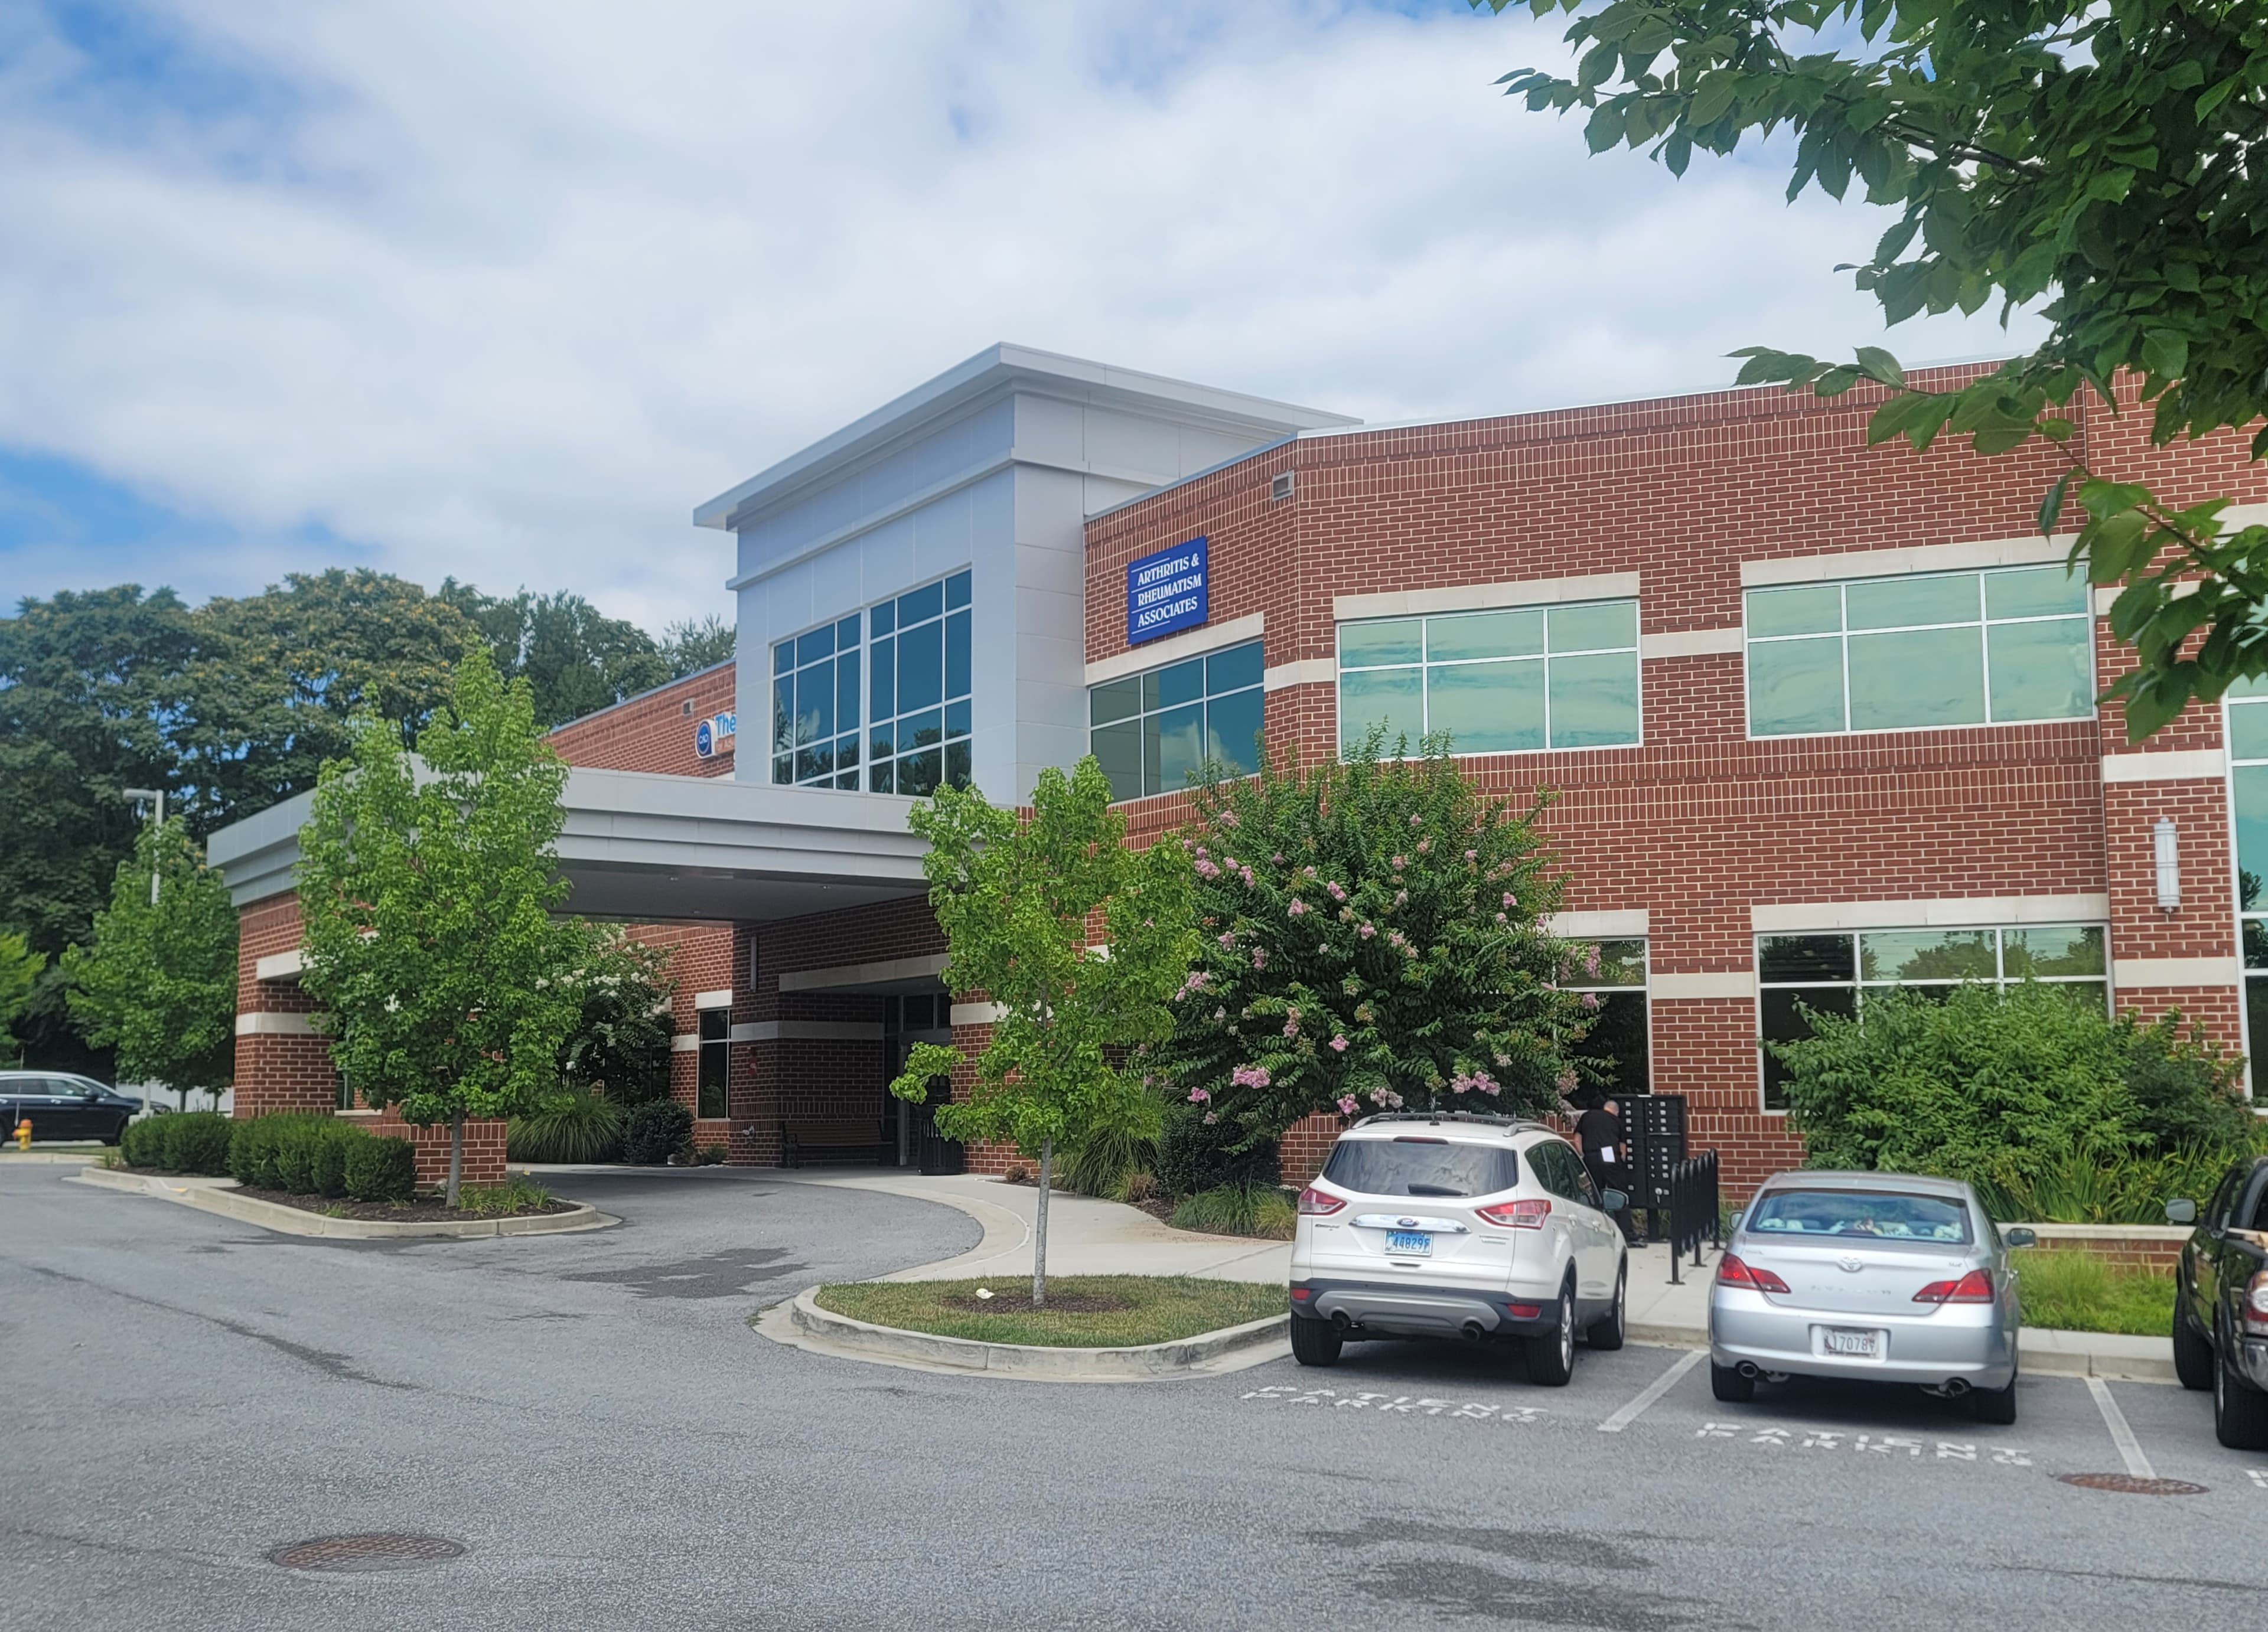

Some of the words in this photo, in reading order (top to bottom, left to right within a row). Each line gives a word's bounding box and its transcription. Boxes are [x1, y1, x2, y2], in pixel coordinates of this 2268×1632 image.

[1137, 556, 1189, 586] ARTHRITIS
[1191, 553, 1200, 567] &
[1138, 573, 1202, 607] RHEUMATISM
[1138, 596, 1198, 628] ASSOCIATES
[714, 713, 737, 738] The
